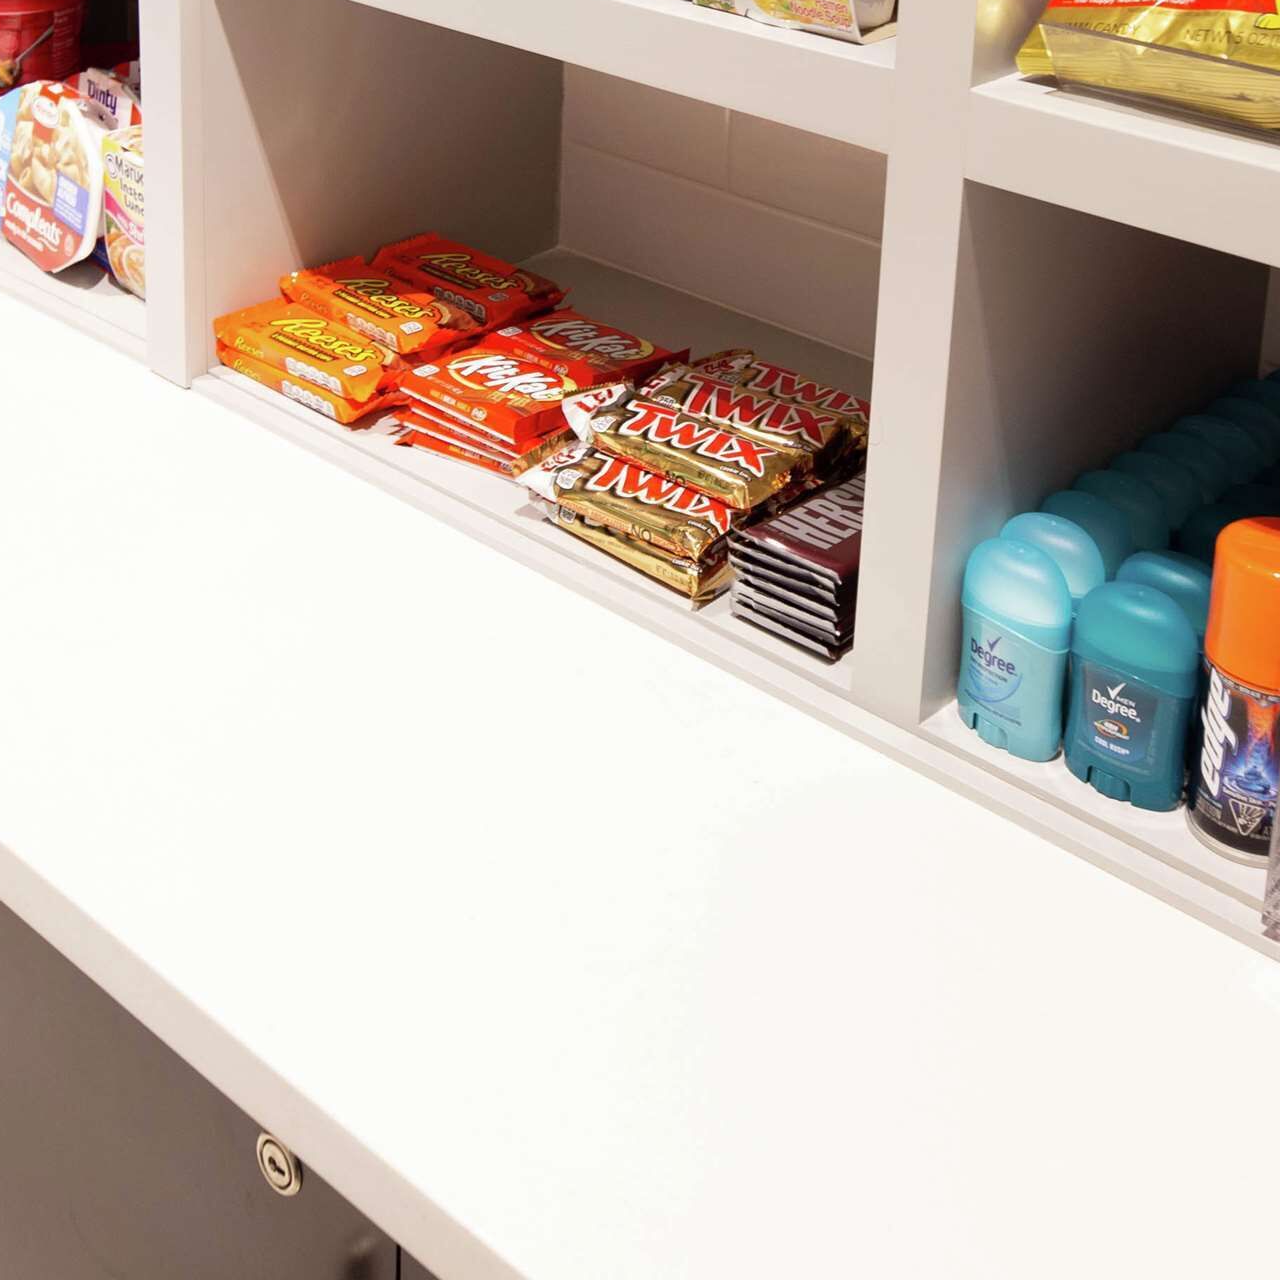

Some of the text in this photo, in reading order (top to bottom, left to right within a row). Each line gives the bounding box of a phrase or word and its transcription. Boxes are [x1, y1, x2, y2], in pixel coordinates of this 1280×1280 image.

[87, 79, 117, 115] Dinty
[120, 180, 144, 203] Insta
[124, 195, 144, 216] Lunc
[420, 253, 518, 289] Reese's
[334, 279, 434, 318] Reese's
[270, 318, 377, 362] Reese's
[682, 373, 834, 447] TWIX
[748, 362, 869, 420] TWIX
[621, 398, 777, 478] TWIX
[585, 452, 737, 535] TWIX
[631, 523, 653, 542] NO
[971, 637, 1016, 675] Degree
[1091, 688, 1138, 720] Degree
[1201, 666, 1238, 797] edge
